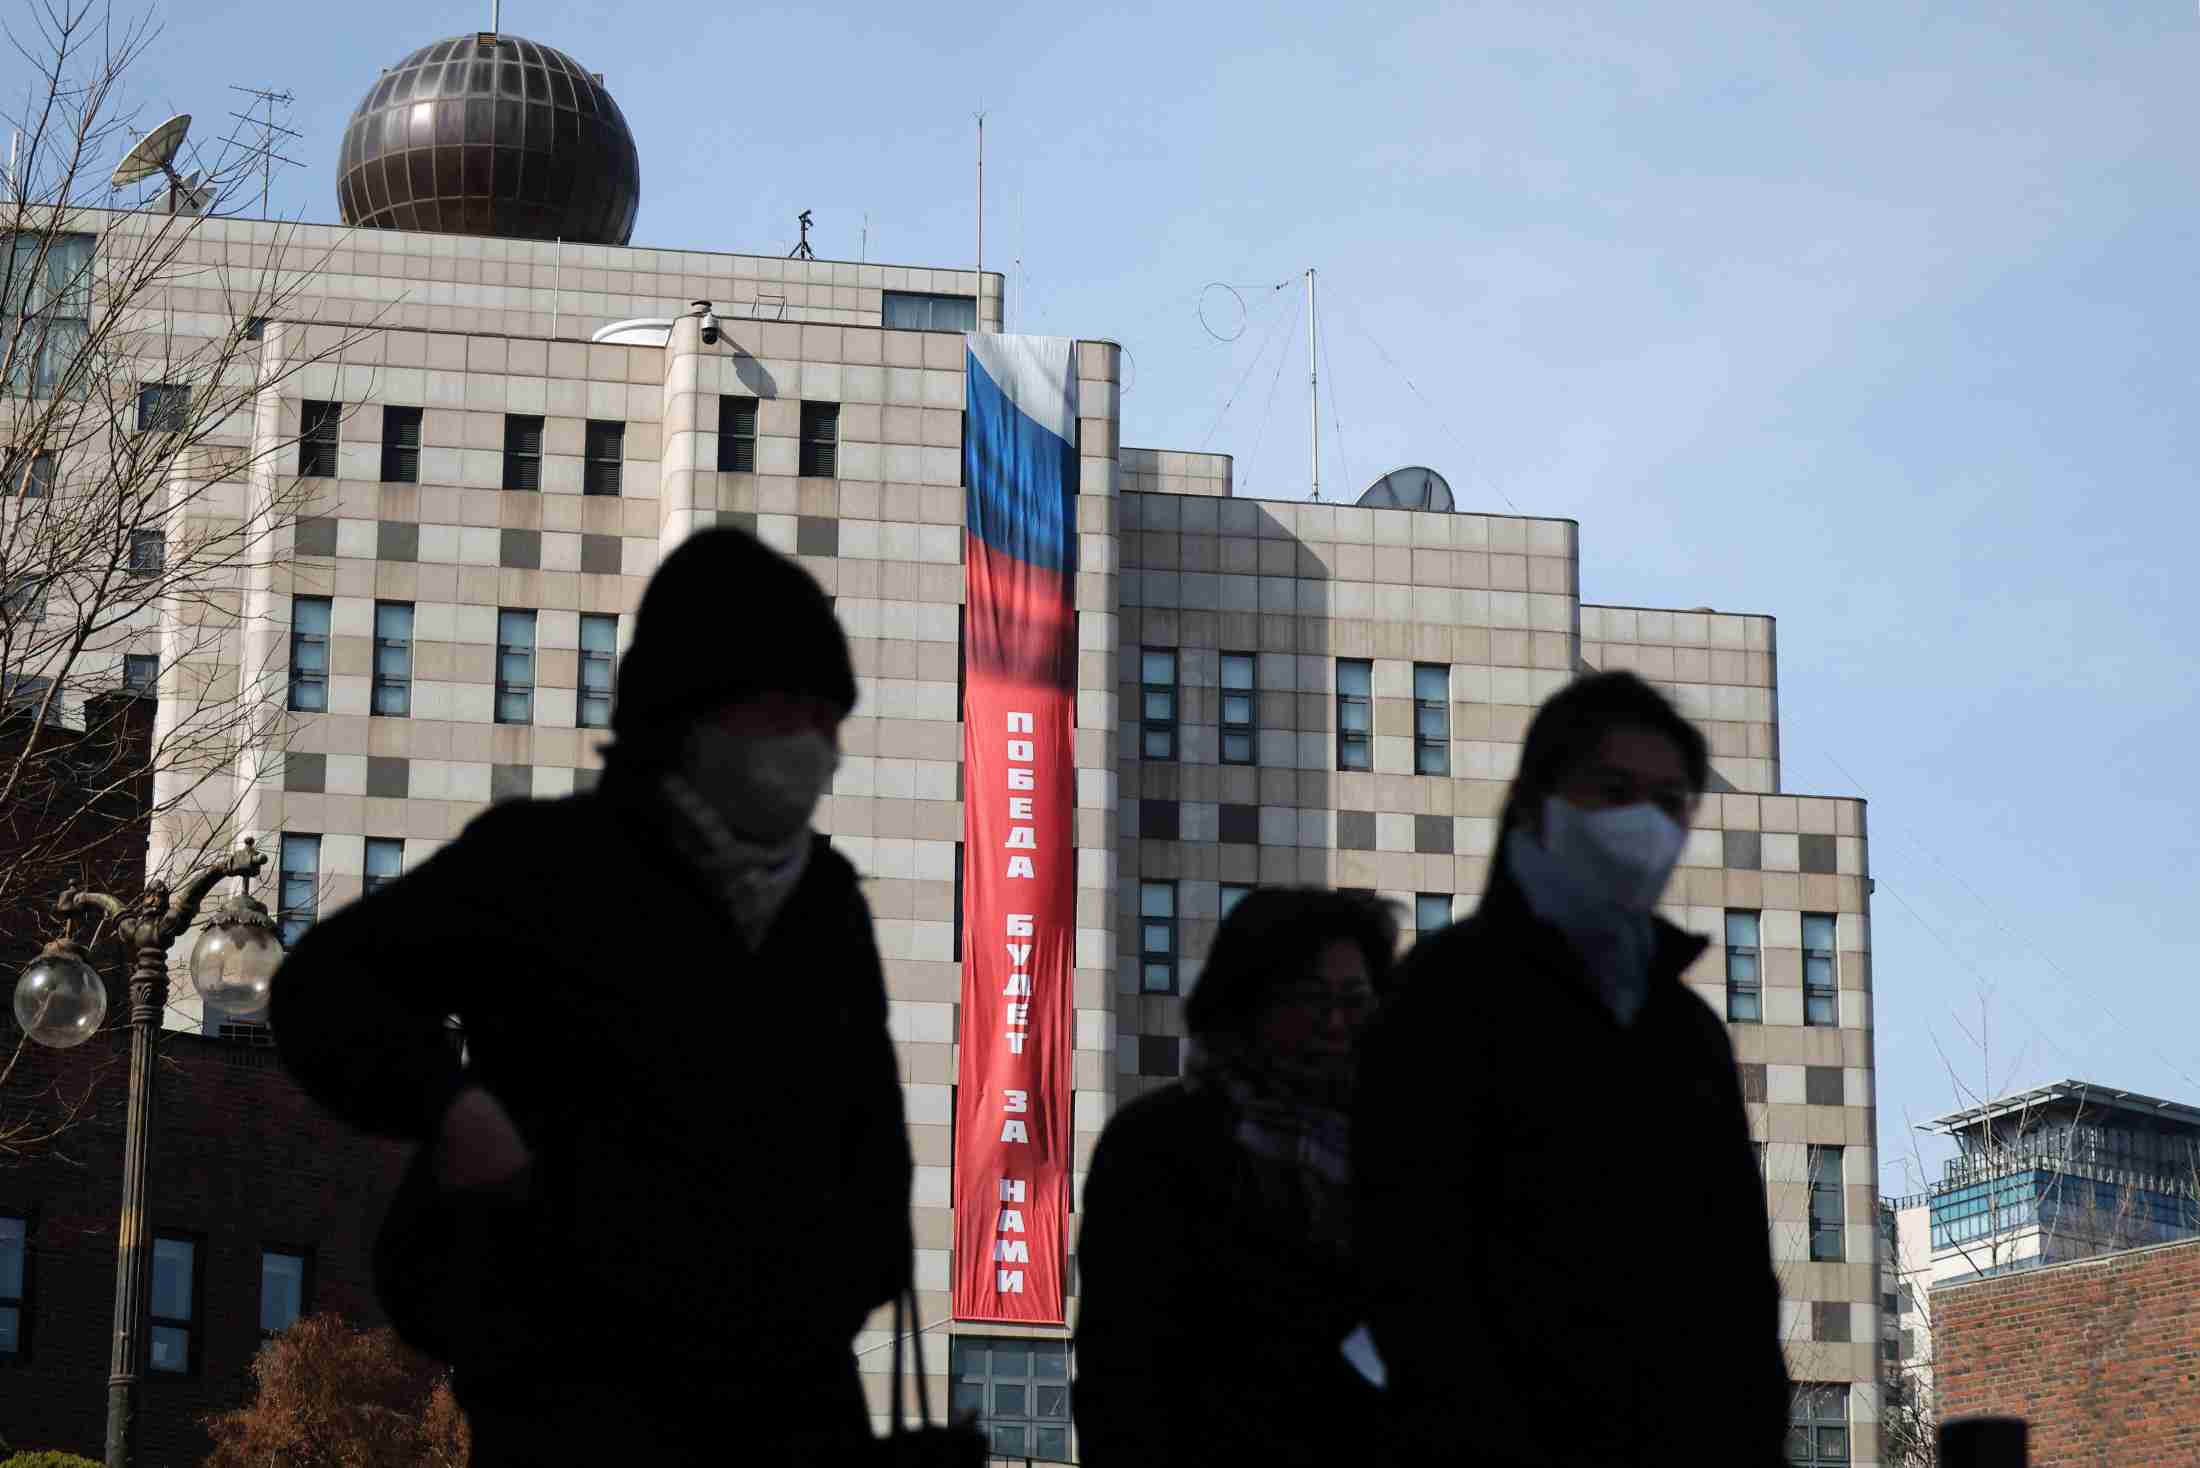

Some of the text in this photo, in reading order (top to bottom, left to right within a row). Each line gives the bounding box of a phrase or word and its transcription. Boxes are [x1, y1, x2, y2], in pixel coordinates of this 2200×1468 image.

[993, 711, 1037, 1294] ПОБЕДА БУДЕТ ЗА НАМИ
